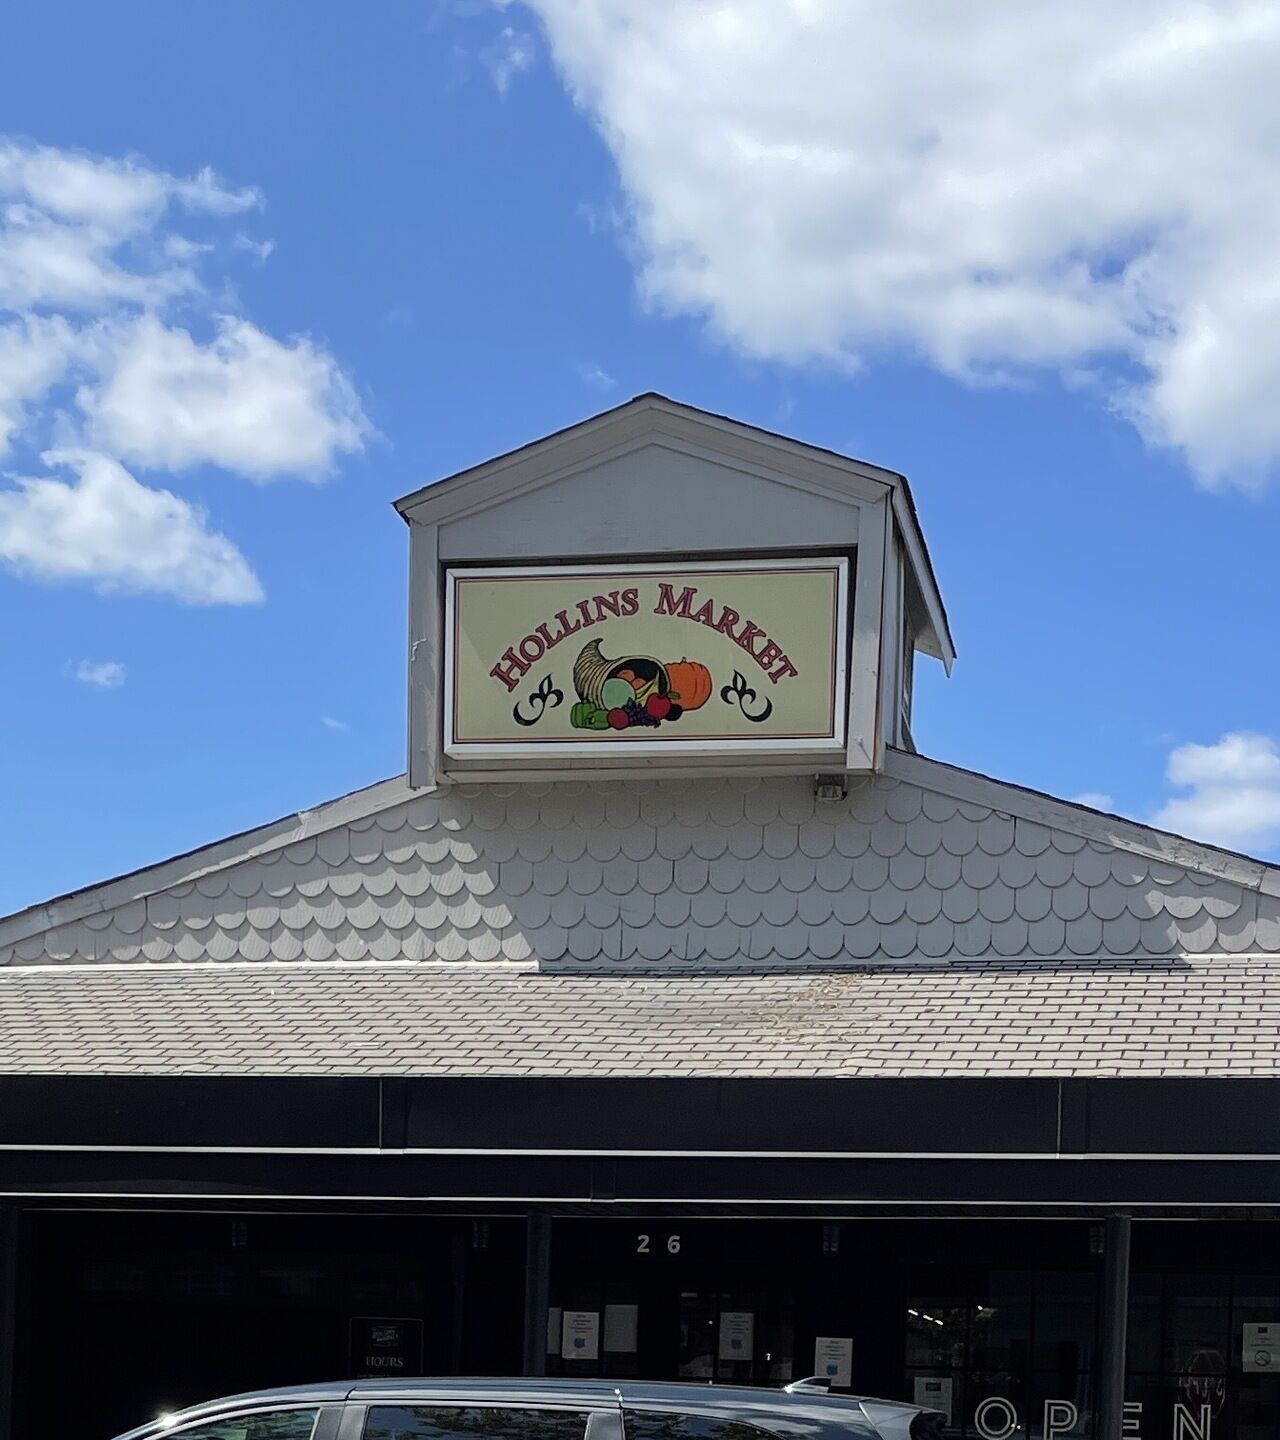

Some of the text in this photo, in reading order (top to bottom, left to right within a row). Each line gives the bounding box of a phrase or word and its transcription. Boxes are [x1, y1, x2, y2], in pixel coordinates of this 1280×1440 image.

[489, 582, 798, 693] HOLLINS MARKET
[366, 1356, 405, 1367] HOURS
